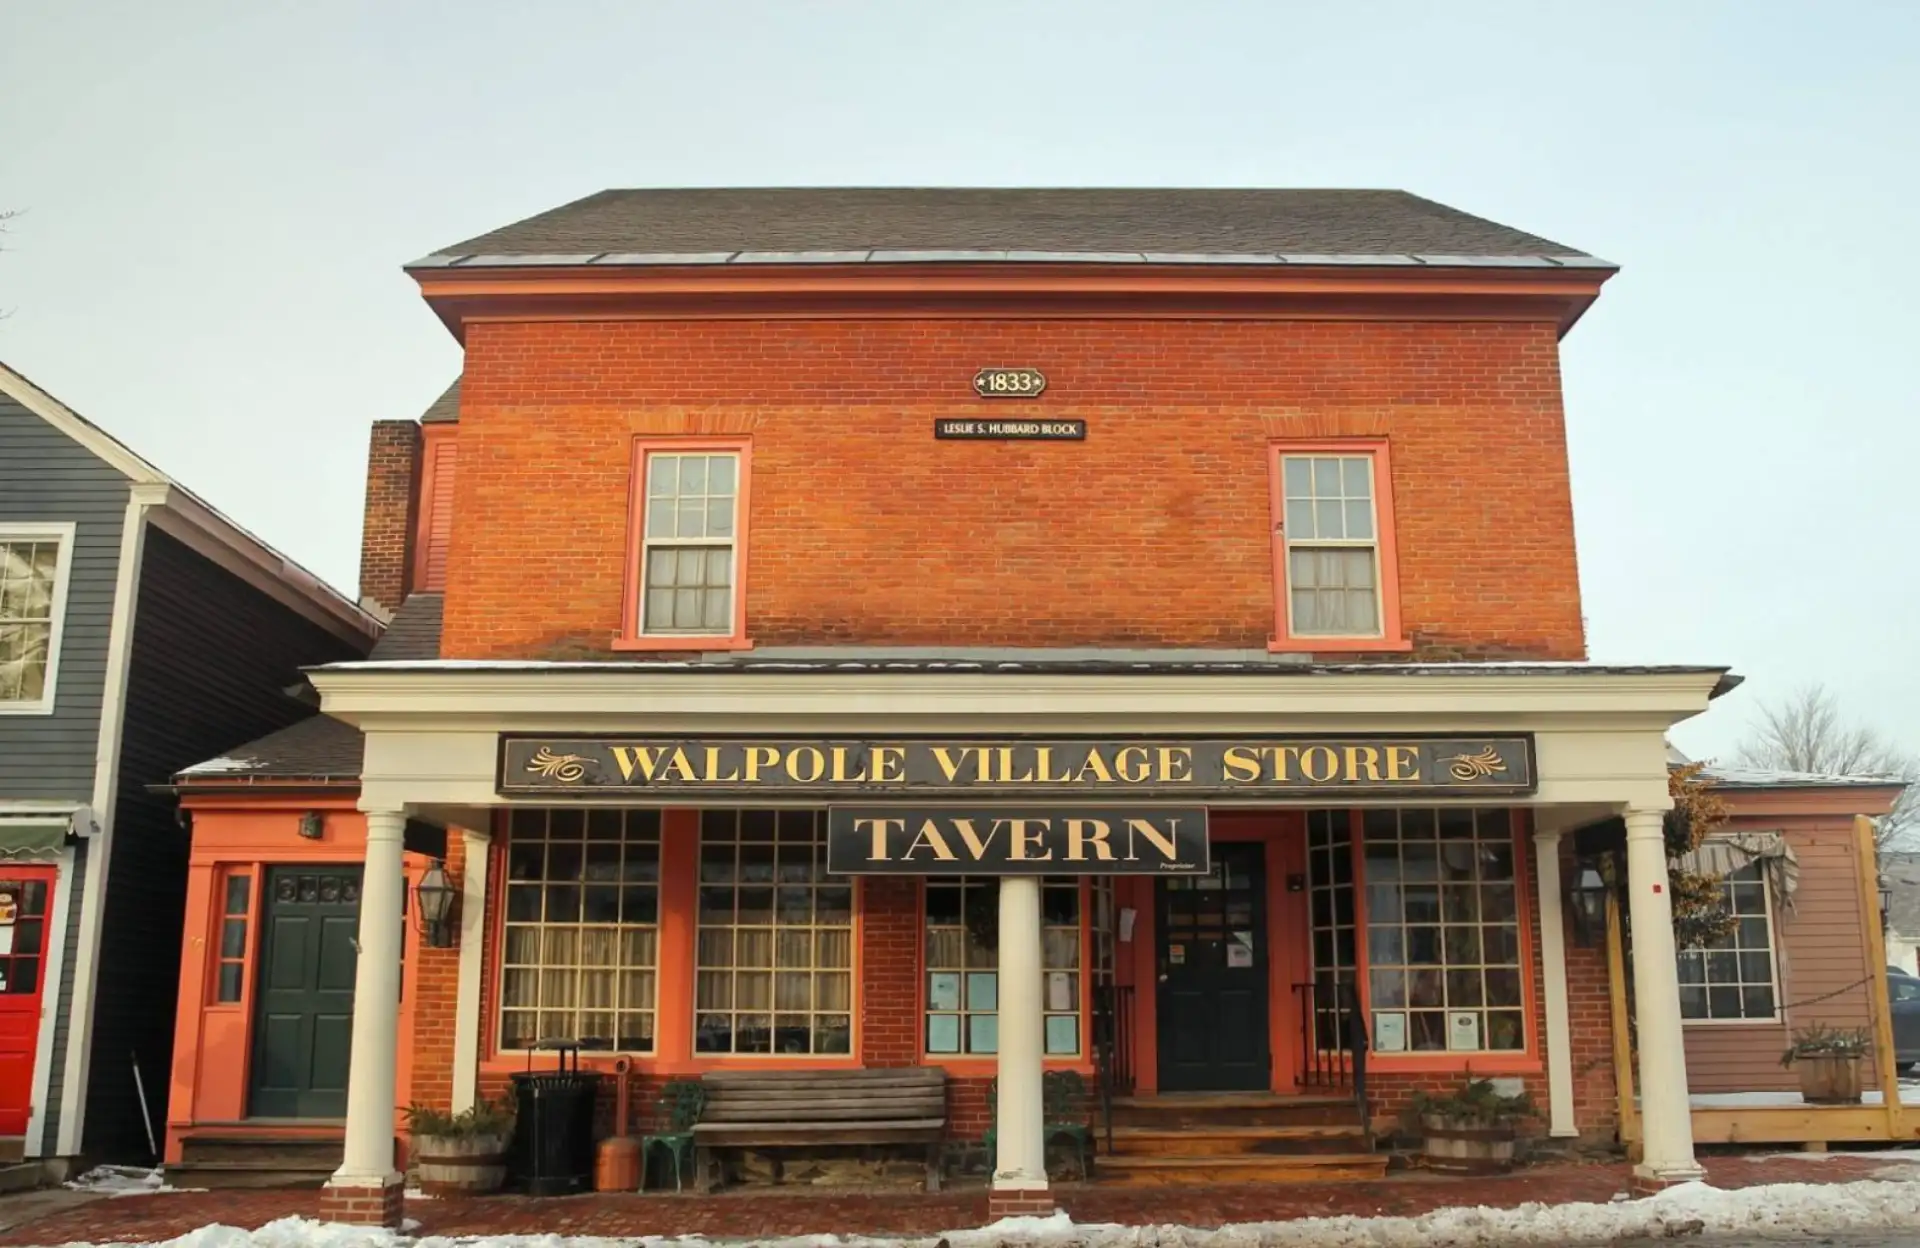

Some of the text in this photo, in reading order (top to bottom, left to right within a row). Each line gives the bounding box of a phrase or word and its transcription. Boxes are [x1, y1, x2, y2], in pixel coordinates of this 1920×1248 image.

[987, 373, 1031, 391] 1833
[944, 424, 1076, 435] LESLIE S. HUBBARD BLOCK
[608, 745, 1421, 782] WALPOLE VILLAGE STORE
[854, 818, 1182, 861] TAVERN
